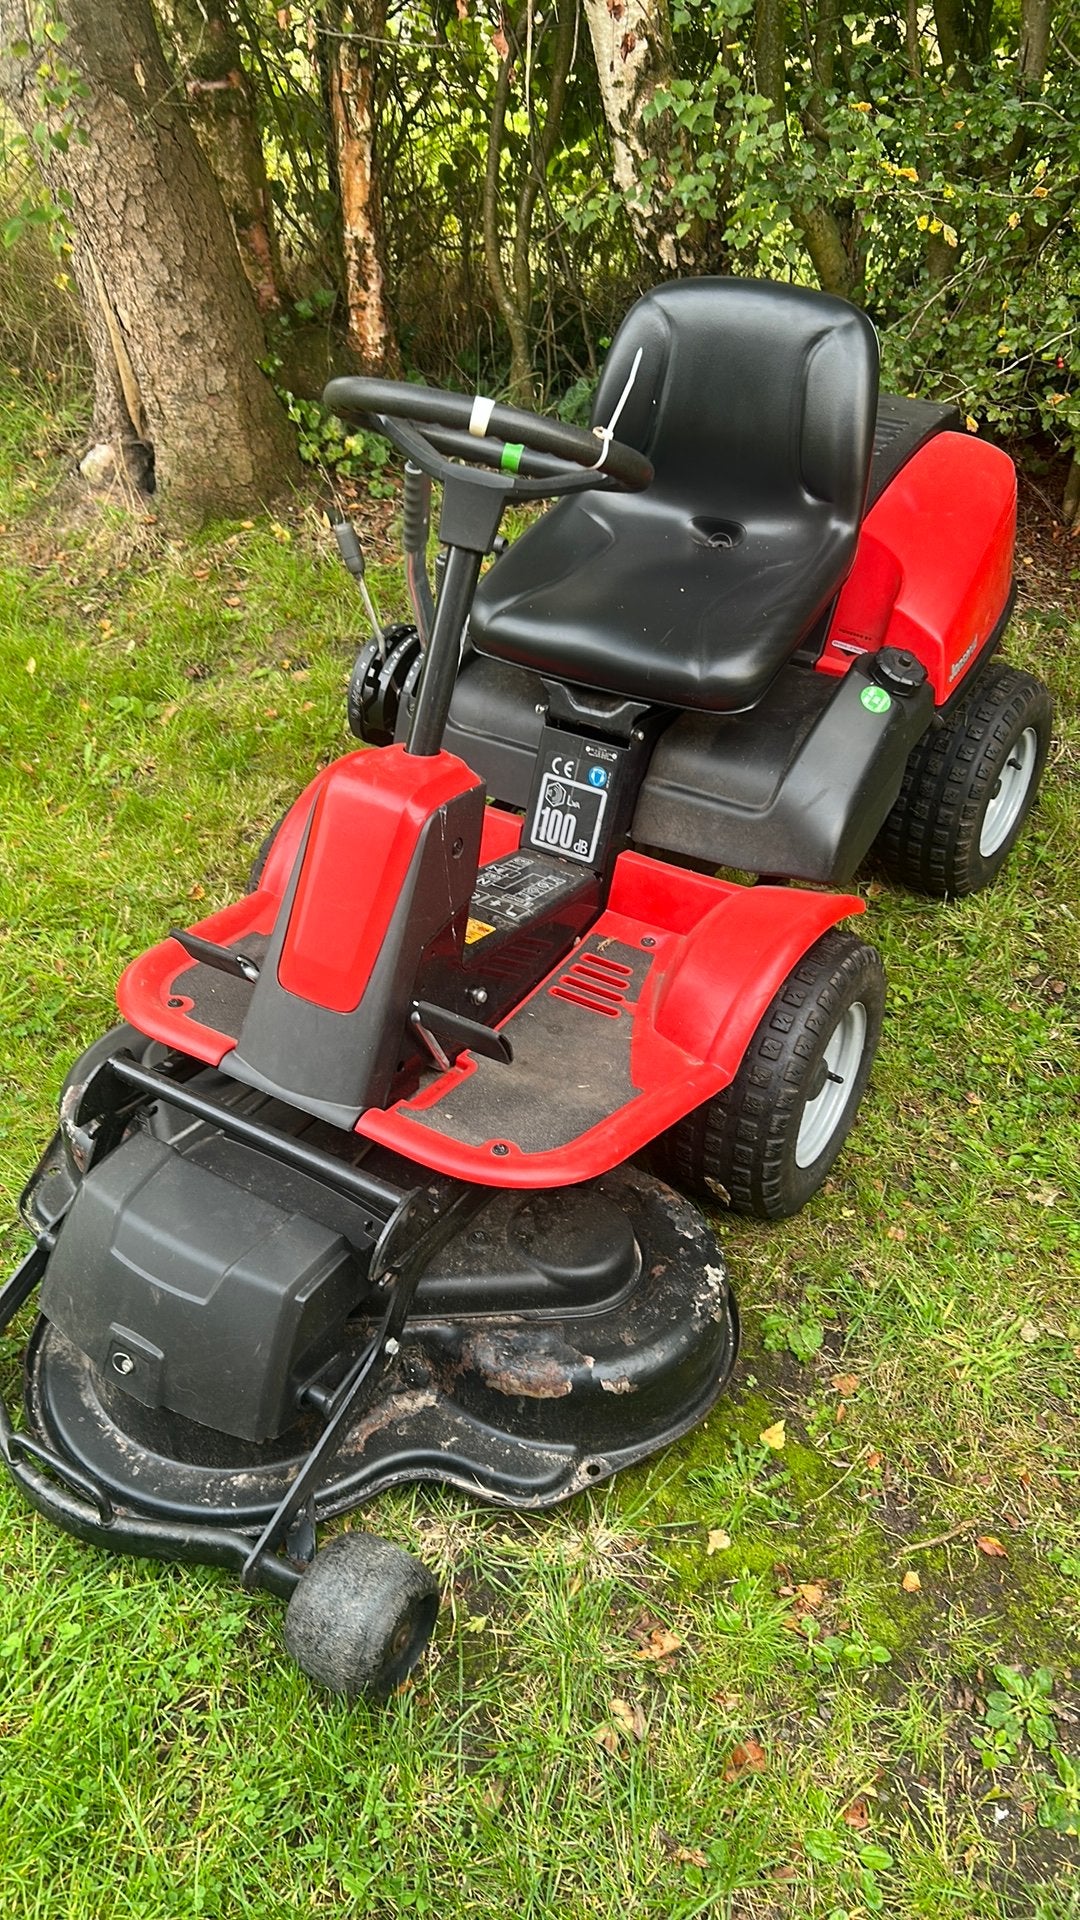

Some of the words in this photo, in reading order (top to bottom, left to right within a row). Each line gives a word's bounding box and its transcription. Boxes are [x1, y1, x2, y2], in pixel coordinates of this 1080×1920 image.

[551, 757, 575, 778] CE
[538, 806, 577, 849] 100
[573, 838, 588, 855] dB
